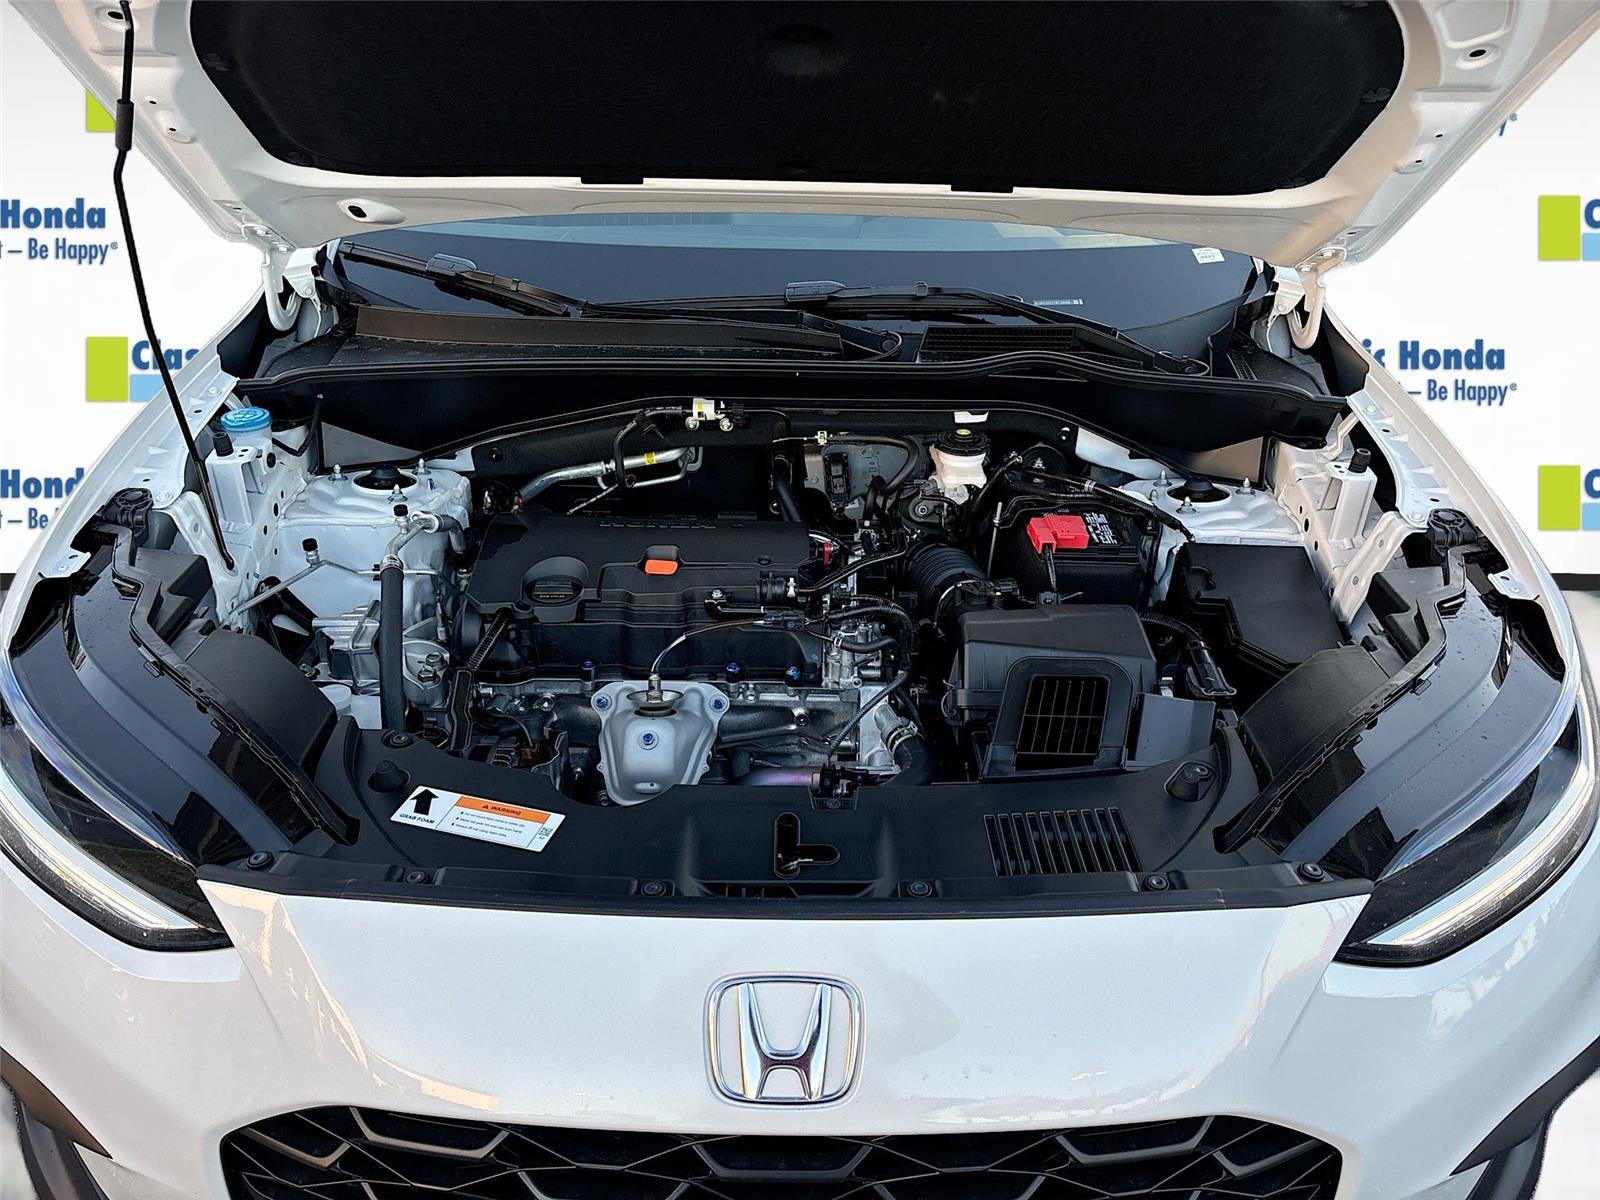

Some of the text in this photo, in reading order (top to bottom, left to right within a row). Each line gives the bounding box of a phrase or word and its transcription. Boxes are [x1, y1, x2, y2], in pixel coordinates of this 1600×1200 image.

[0, 197, 106, 229] Honda
[28, 237, 49, 260] Be
[1399, 338, 1505, 370] Honda
[1427, 379, 1448, 401] Be
[28, 507, 49, 529] Be
[400, 813, 435, 825] GRAB FOAM
[490, 806, 522, 816] WARNING
